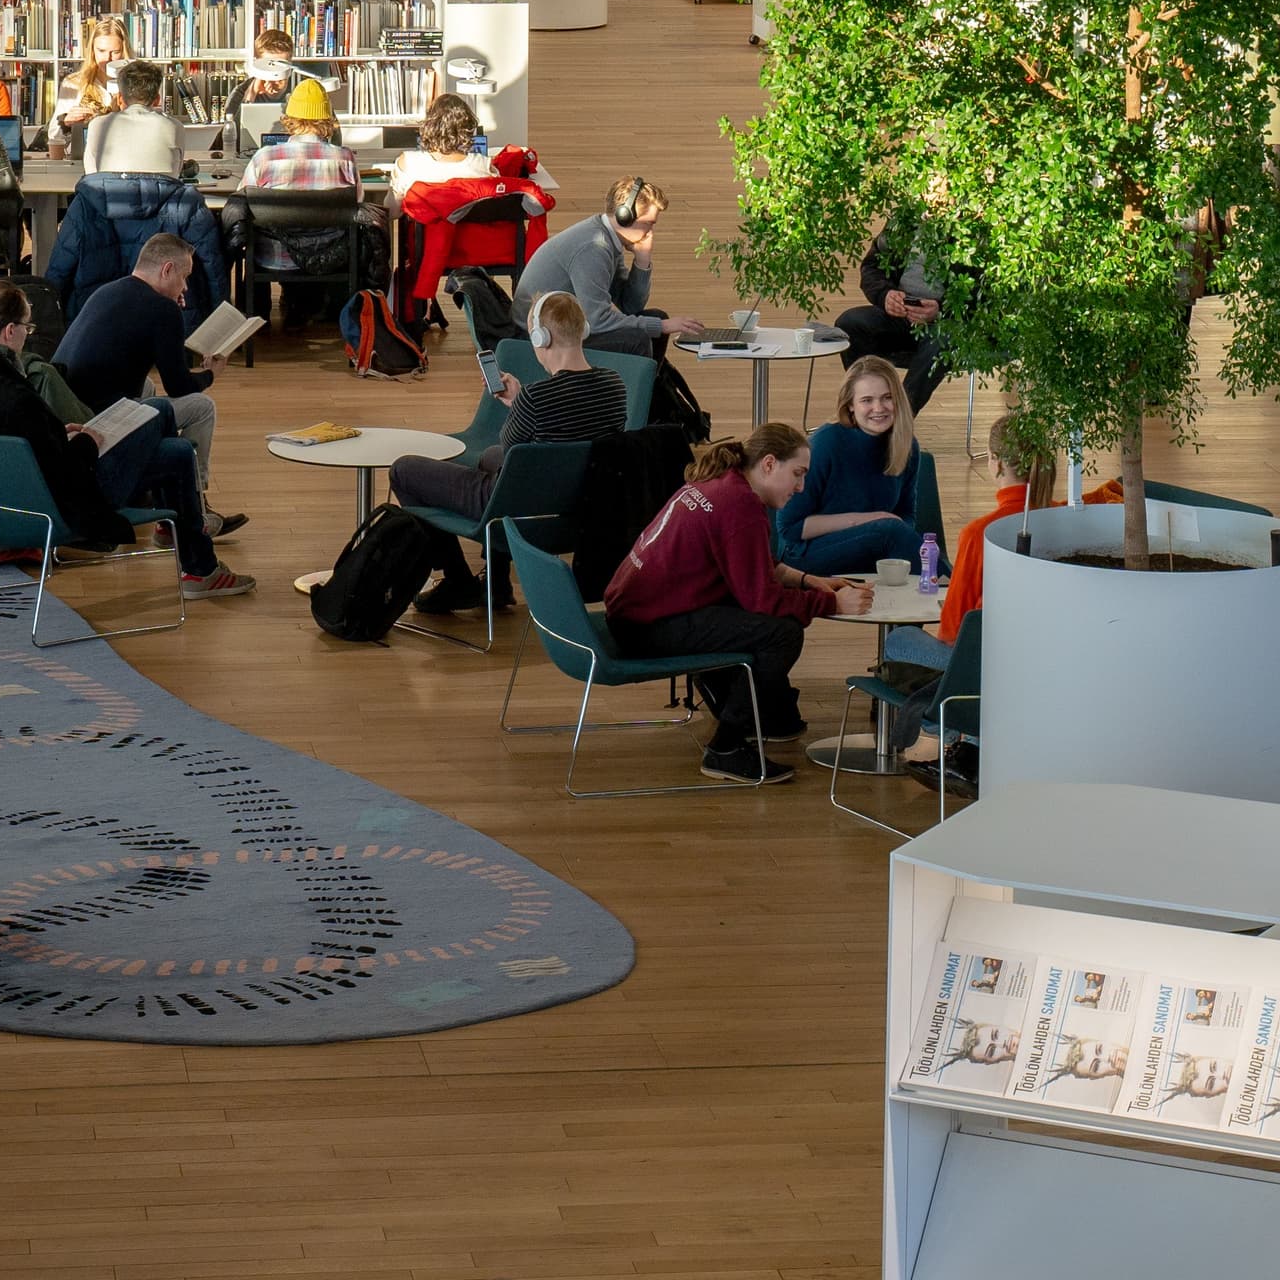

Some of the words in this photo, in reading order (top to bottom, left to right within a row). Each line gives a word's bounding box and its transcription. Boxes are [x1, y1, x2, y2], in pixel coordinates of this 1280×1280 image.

[909, 1001, 949, 1079] TÖÖLÖNLAHDEN
[939, 952, 961, 999] SANOMAT
[1013, 1017, 1052, 1095] TÖÖLÖNLAHDEN
[1041, 966, 1063, 1015] SANOMAT
[1127, 1036, 1163, 1112] TÖÖLÖNLAHDEN
[1153, 983, 1173, 1033] SANOMAT
[1228, 1047, 1266, 1127] TÖÖLÖNLAHDEN
[1256, 995, 1277, 1045] SANOMAT
